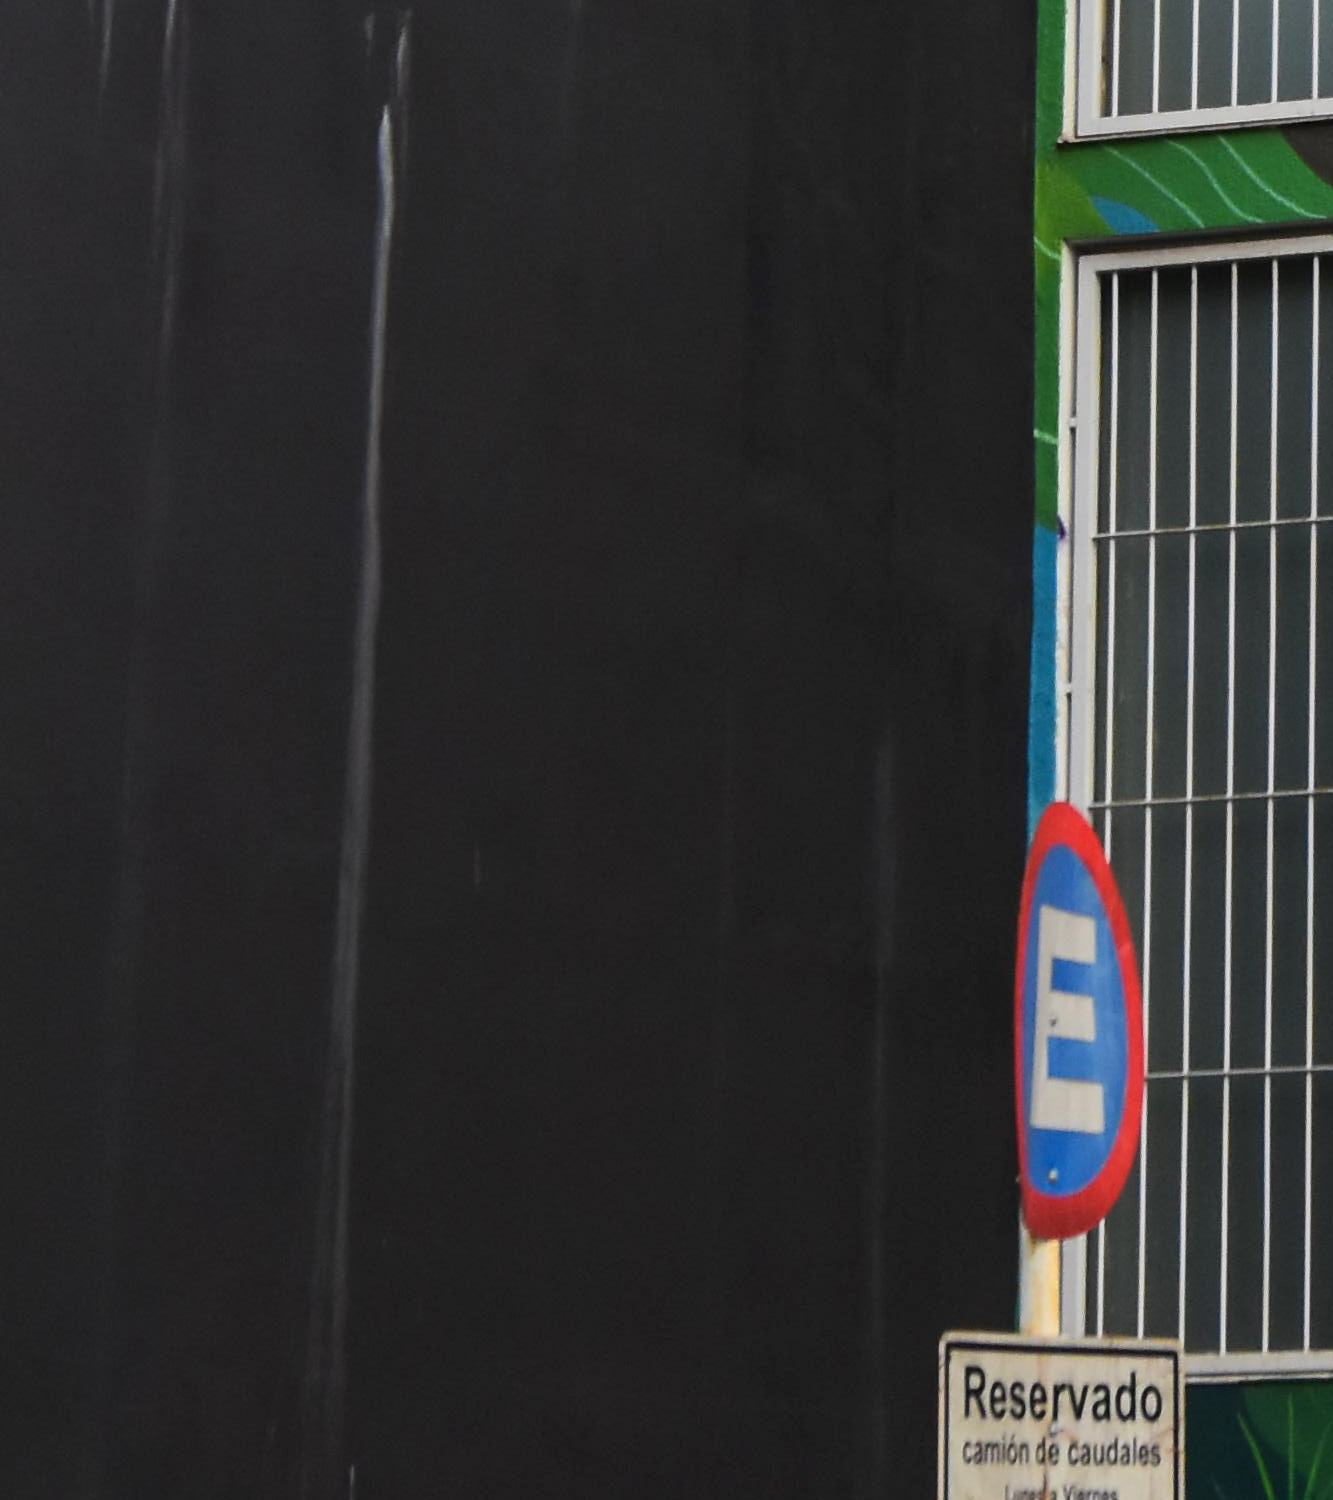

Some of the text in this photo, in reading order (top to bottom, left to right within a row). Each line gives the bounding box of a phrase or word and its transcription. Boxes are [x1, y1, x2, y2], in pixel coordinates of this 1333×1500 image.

[1030, 904, 1105, 1134] E
[964, 1365, 1163, 1422] Reservado
[963, 1431, 1162, 1467] camión de caudales
